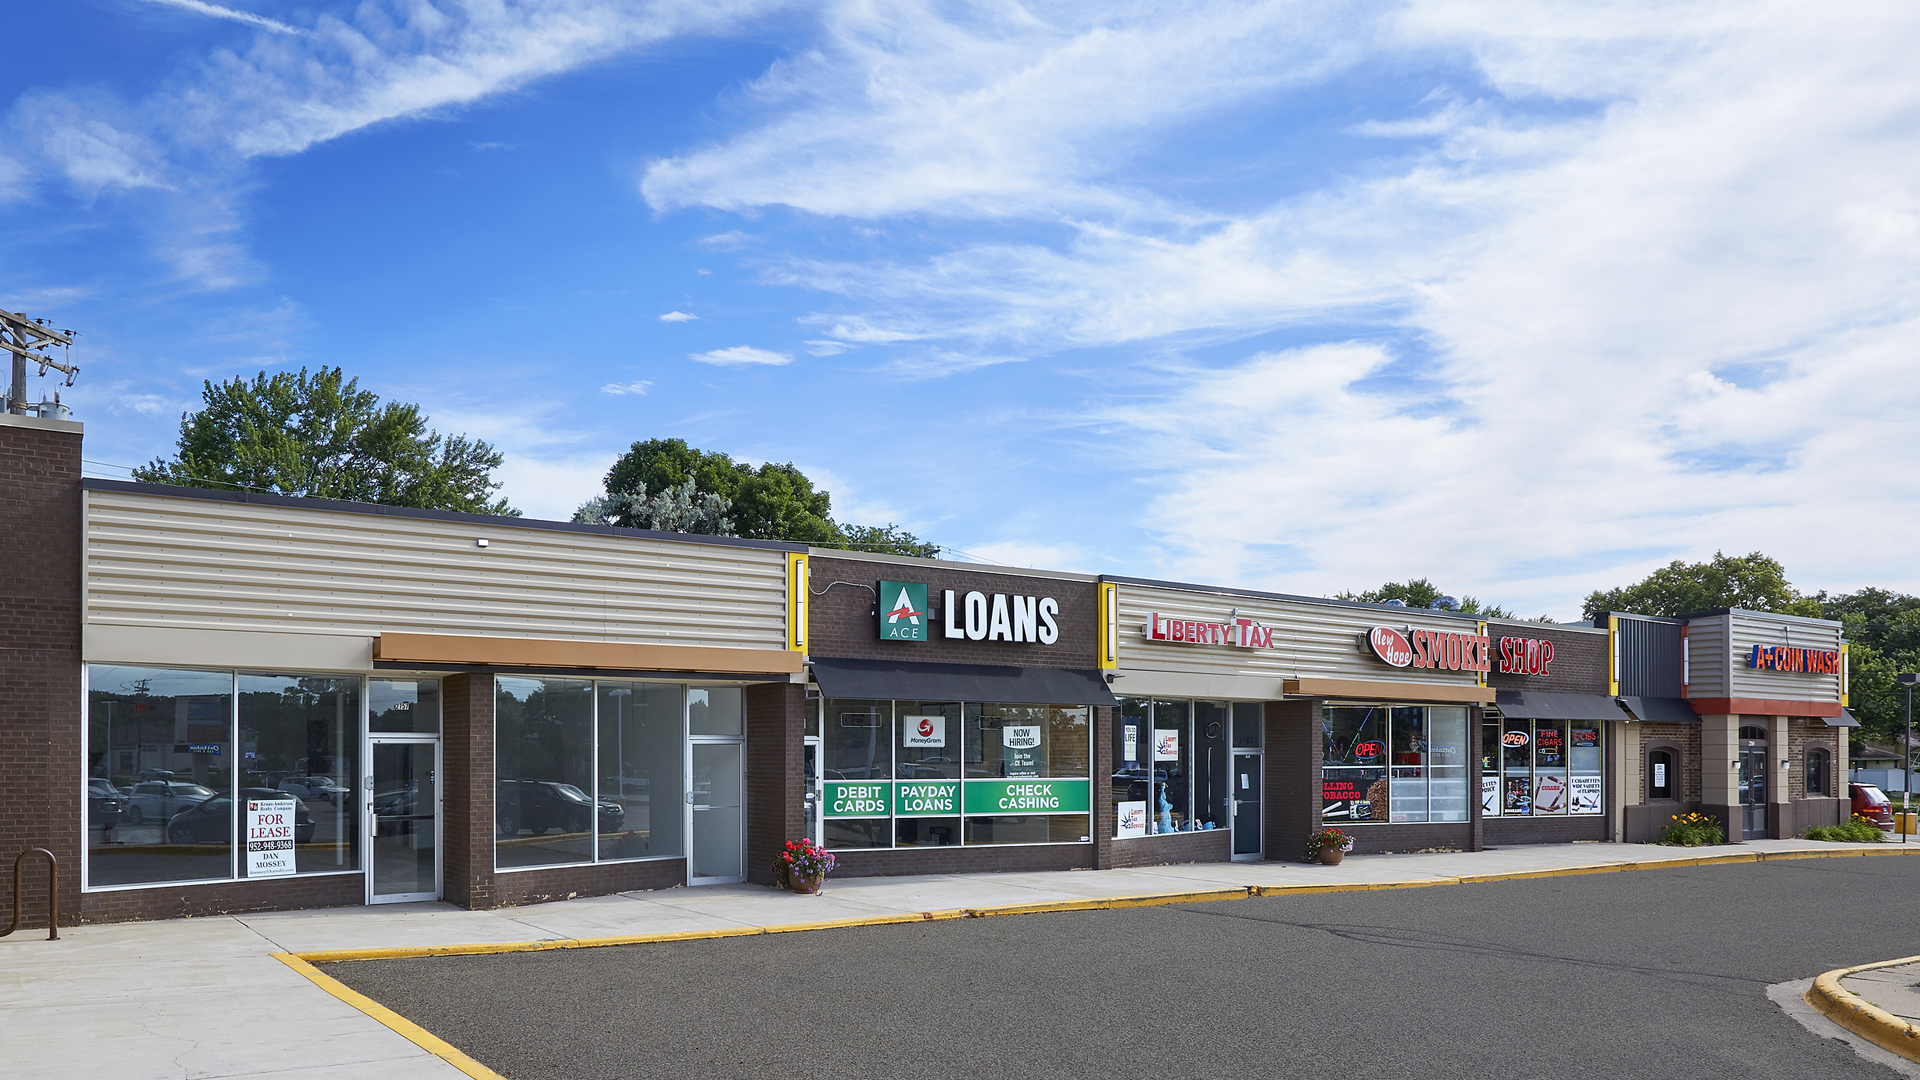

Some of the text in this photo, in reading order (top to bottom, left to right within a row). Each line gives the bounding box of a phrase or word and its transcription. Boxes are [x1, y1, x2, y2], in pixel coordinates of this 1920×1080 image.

[945, 590, 1058, 645] LOANS
[890, 627, 918, 638] ACE
[1150, 612, 1274, 648] LIBERTY TAX
[1374, 628, 1394, 646] New
[1386, 646, 1410, 664] Hope
[1413, 629, 1554, 676] SMOKE SHOP
[1756, 645, 1839, 674] A+ COIN WASH
[1014, 729, 1030, 737] NOW
[1125, 734, 1136, 742] LIFE
[1574, 731, 1596, 741] E-CIGS
[1010, 738, 1034, 746] HIRING!
[1503, 734, 1526, 745] OPEN
[1355, 743, 1382, 756] OPEN
[838, 787, 882, 798] DEBIT
[901, 786, 956, 798] PAYDAY
[1006, 784, 1052, 796] CHECK
[834, 800, 884, 812] CARDS
[904, 799, 952, 811] LOANS
[999, 797, 1059, 809] CASHING
[258, 814, 283, 825] FOR
[251, 827, 291, 838] LEASE
[250, 841, 292, 851] 952-948-9368
